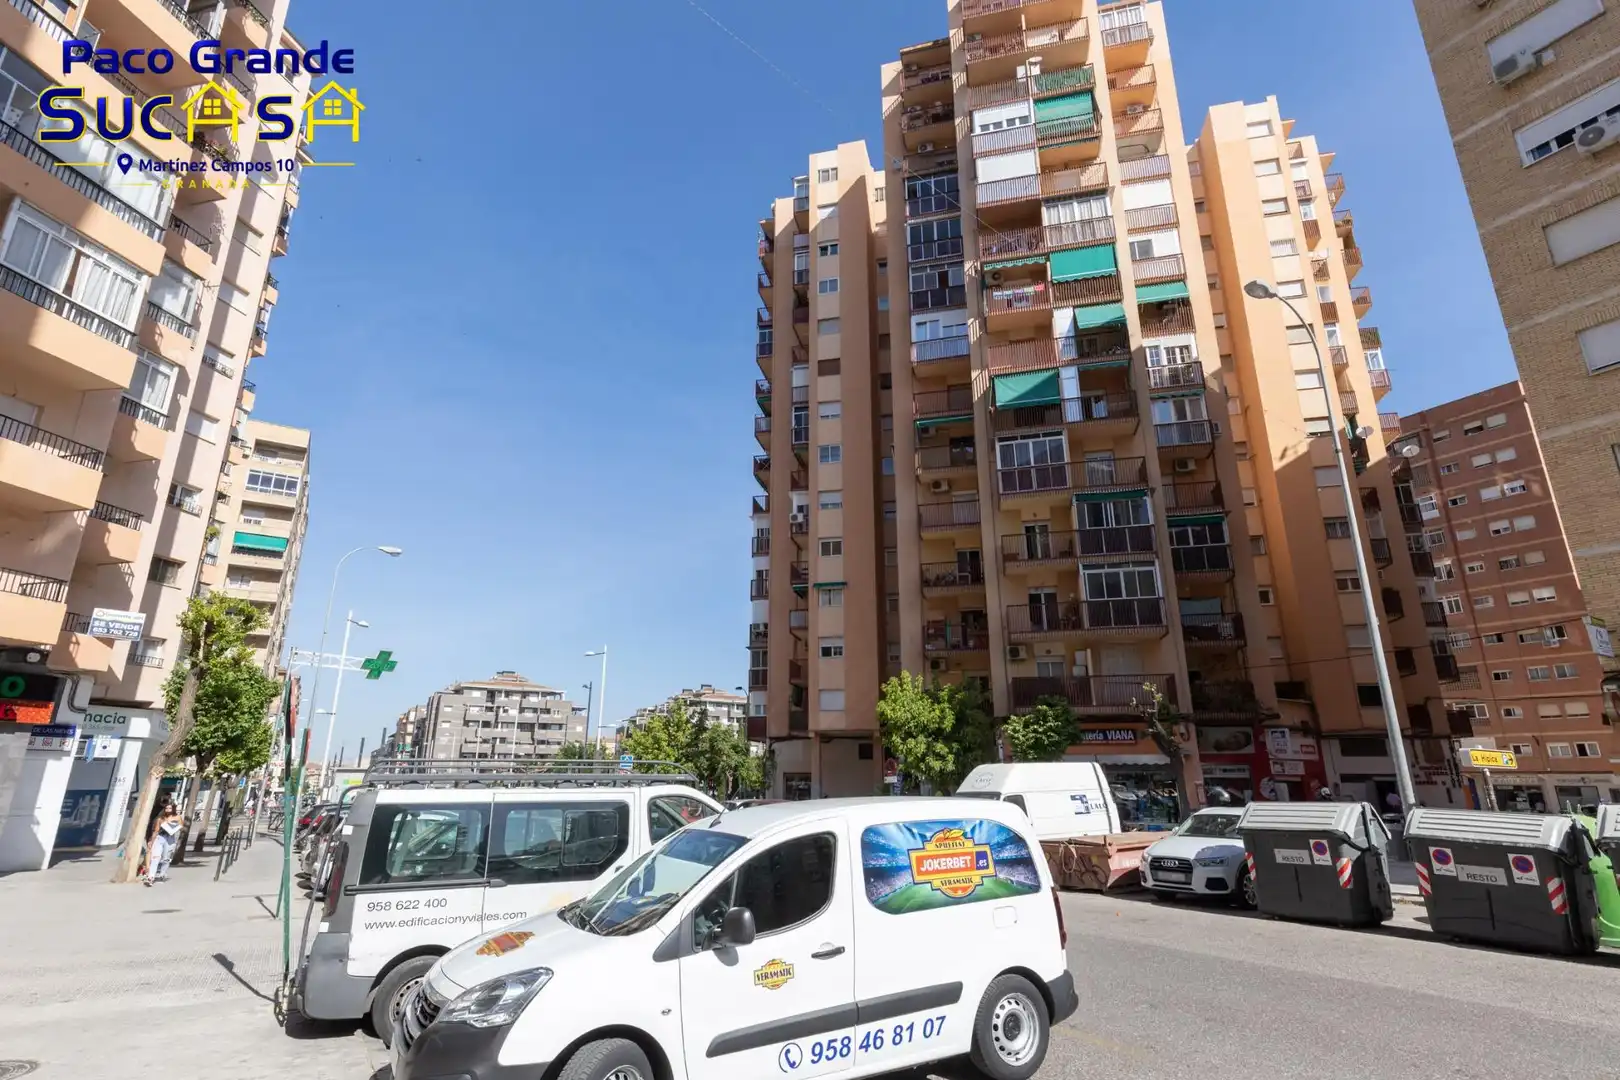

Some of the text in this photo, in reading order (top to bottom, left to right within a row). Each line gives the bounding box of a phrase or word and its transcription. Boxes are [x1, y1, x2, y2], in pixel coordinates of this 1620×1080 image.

[108, 622, 140, 631] VENDE
[1106, 730, 1134, 740] VIANA
[920, 856, 972, 872] JOKERBET
[1466, 873, 1498, 883] RESTO
[367, 898, 448, 912] 958 622 400
[364, 911, 527, 930] www.edificacionyviales.com
[810, 1015, 946, 1064] 958 46 81 07
